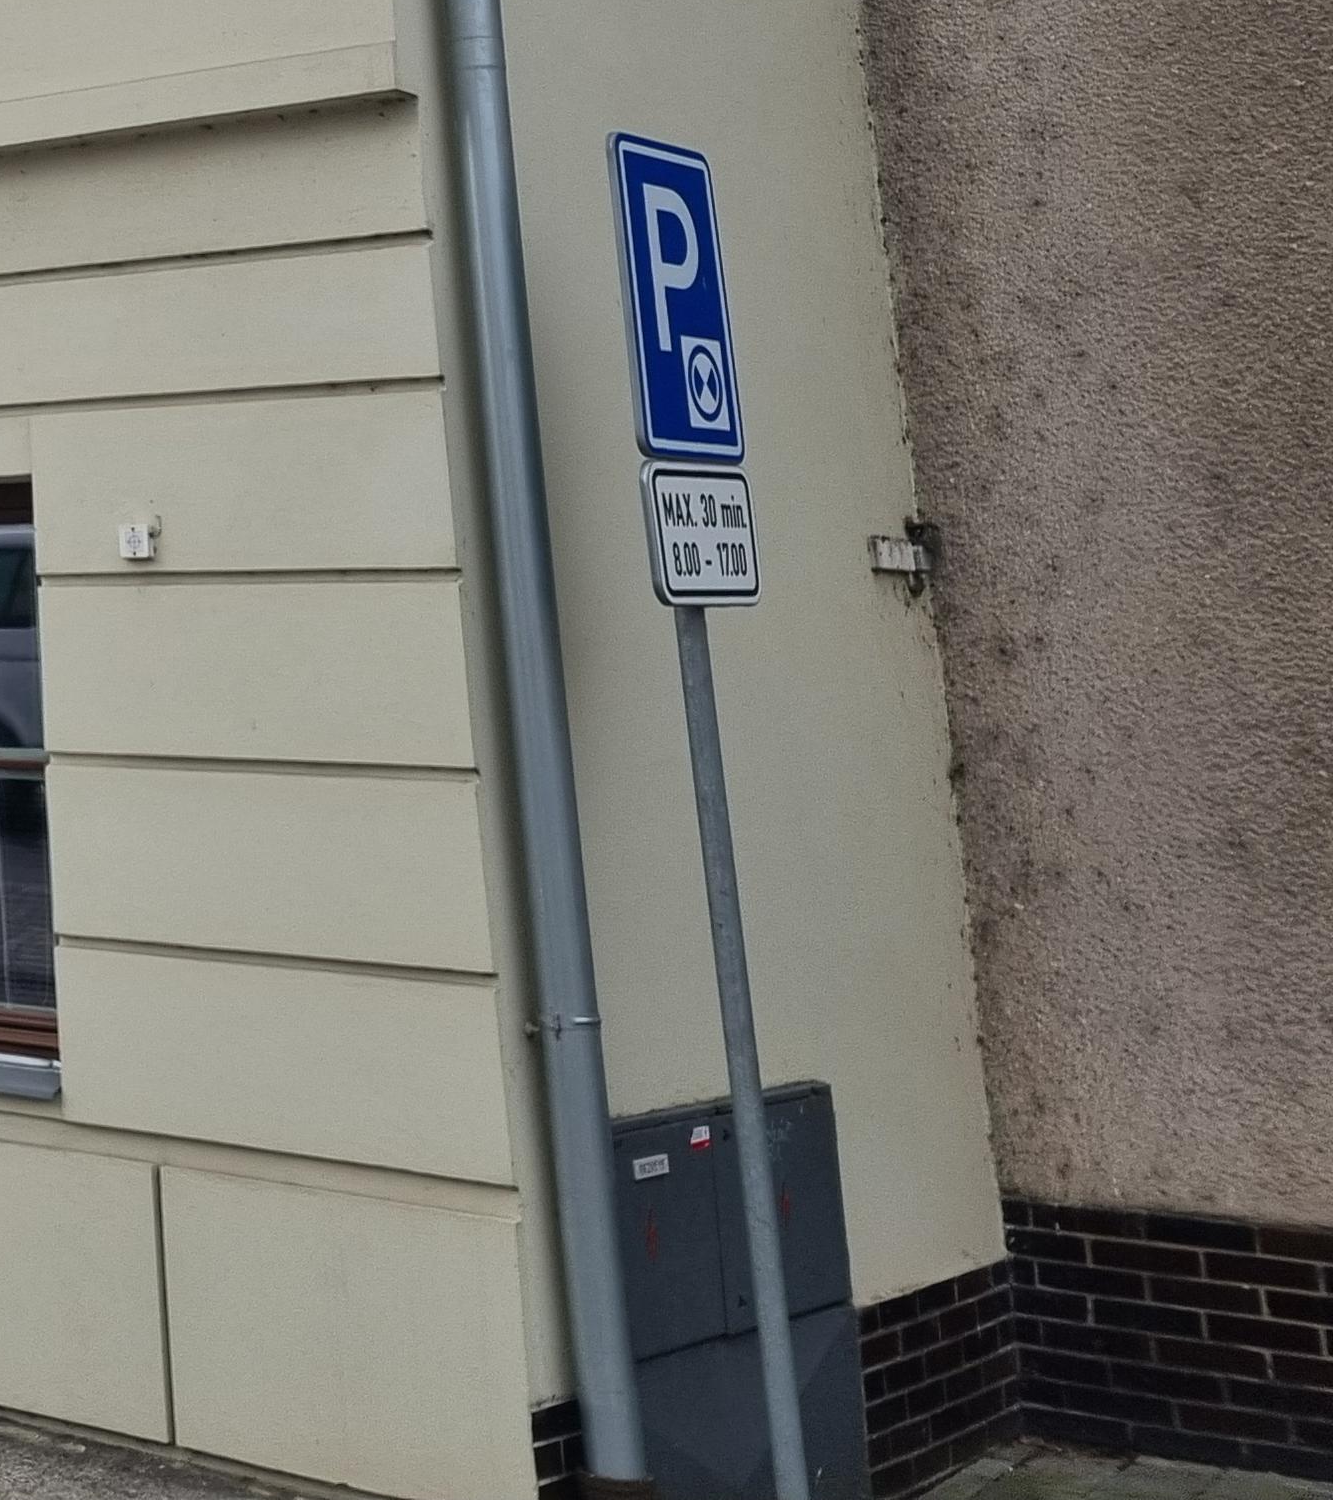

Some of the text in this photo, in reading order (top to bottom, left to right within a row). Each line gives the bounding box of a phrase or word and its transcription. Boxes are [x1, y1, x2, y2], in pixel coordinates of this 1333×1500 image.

[642, 183, 699, 351] P
[661, 492, 747, 528] MAX. 30 min.
[673, 542, 702, 576] 8.00
[716, 542, 748, 576] 17.00
